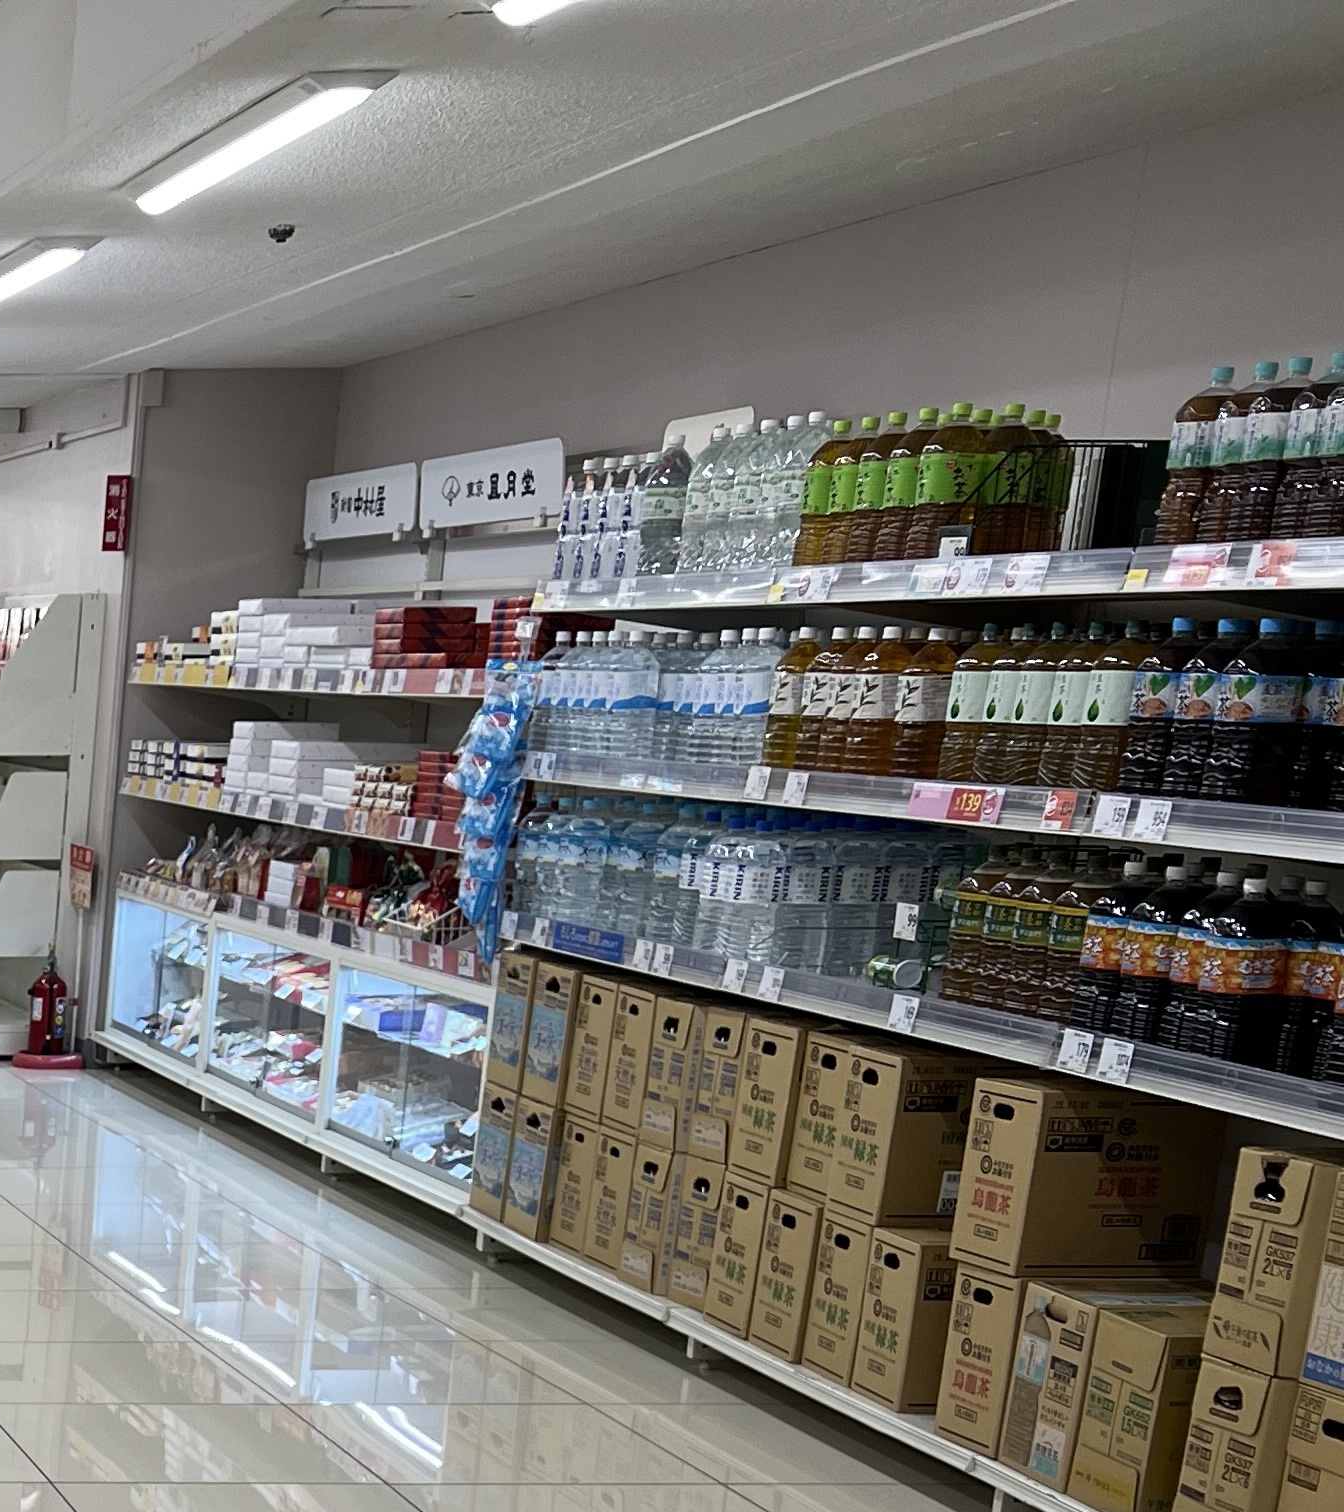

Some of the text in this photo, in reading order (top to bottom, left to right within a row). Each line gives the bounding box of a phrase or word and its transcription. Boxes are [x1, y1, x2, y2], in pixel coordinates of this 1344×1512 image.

[687, 853, 699, 887] KIRIN
[709, 861, 721, 898] KIRIN
[733, 864, 748, 901] KIRIN
[771, 866, 785, 903] KIRIN
[781, 865, 793, 902] KIRIN
[818, 866, 831, 903] KIRIN
[833, 865, 846, 902] KIRIN
[871, 866, 885, 903] KIRIN
[880, 865, 892, 902] KIRIN
[918, 866, 932, 903] KIRIN
[752, 1106, 777, 1133] 緑茶
[812, 1121, 837, 1148] 緑茶
[853, 1137, 880, 1166] 緑茶
[971, 1186, 1013, 1216] 烏龍茶
[1094, 1175, 1161, 1198] 烏龍茶
[725, 1258, 747, 1285] 緑茶
[772, 1278, 795, 1308] 緑茶
[825, 1301, 850, 1331] 緑茶
[875, 1323, 900, 1354] 緑茶
[952, 1368, 992, 1400] 烏龍茶
